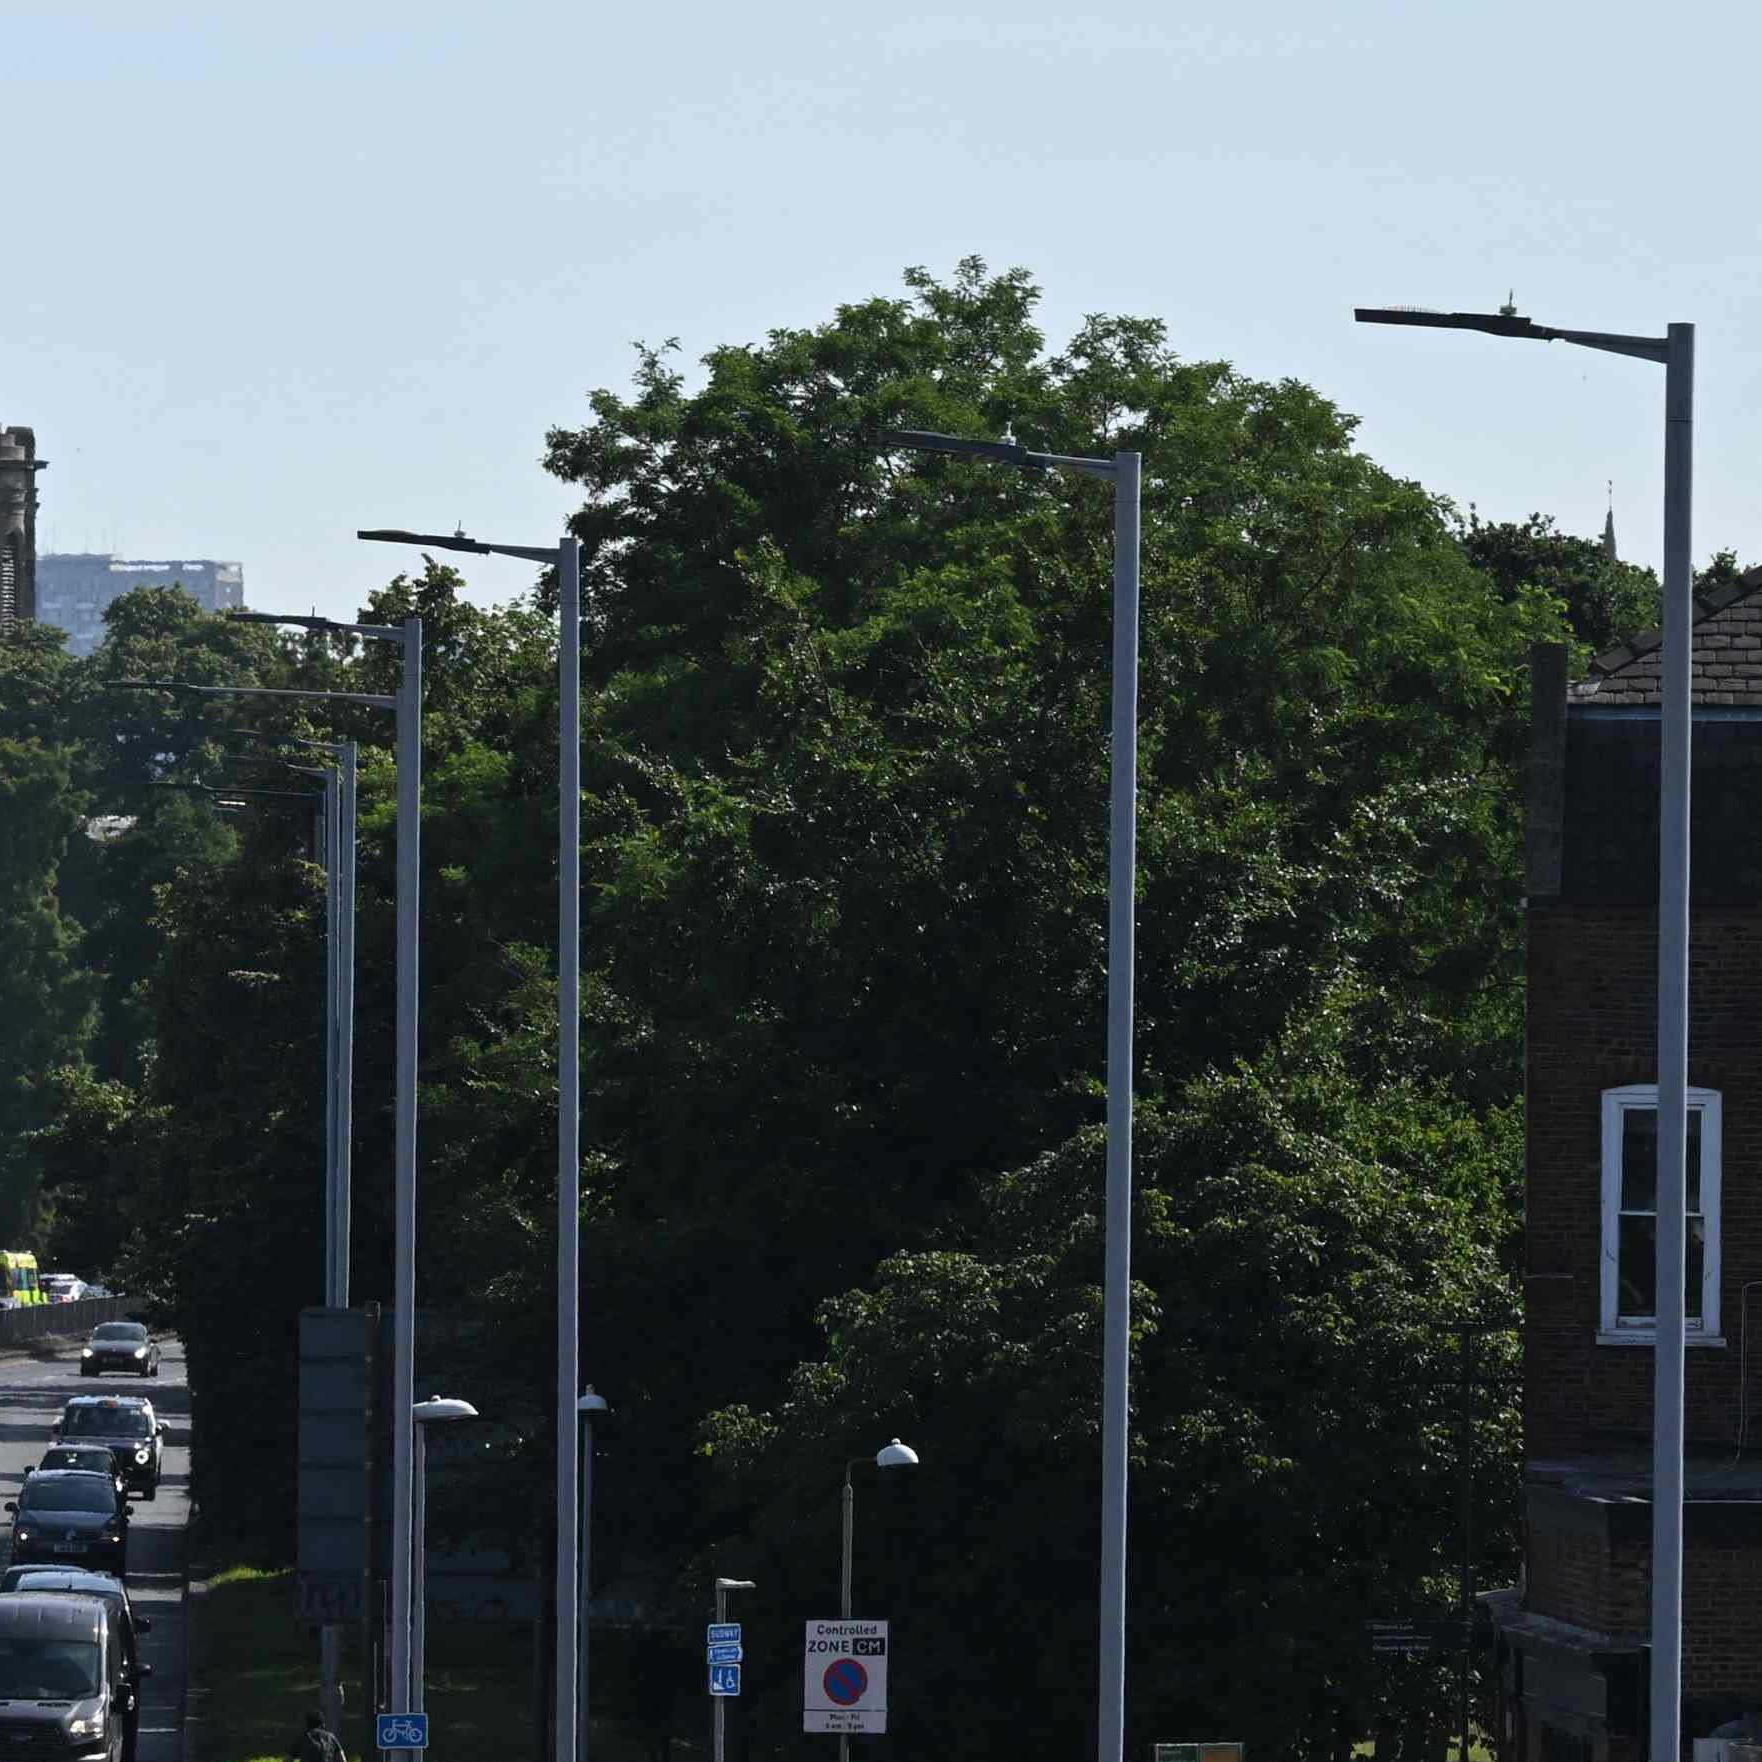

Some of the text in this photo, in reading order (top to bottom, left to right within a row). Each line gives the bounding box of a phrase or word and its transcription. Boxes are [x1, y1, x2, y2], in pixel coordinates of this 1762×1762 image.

[817, 1625, 878, 1636] Controlled
[808, 1639, 882, 1654] ZONE CM
